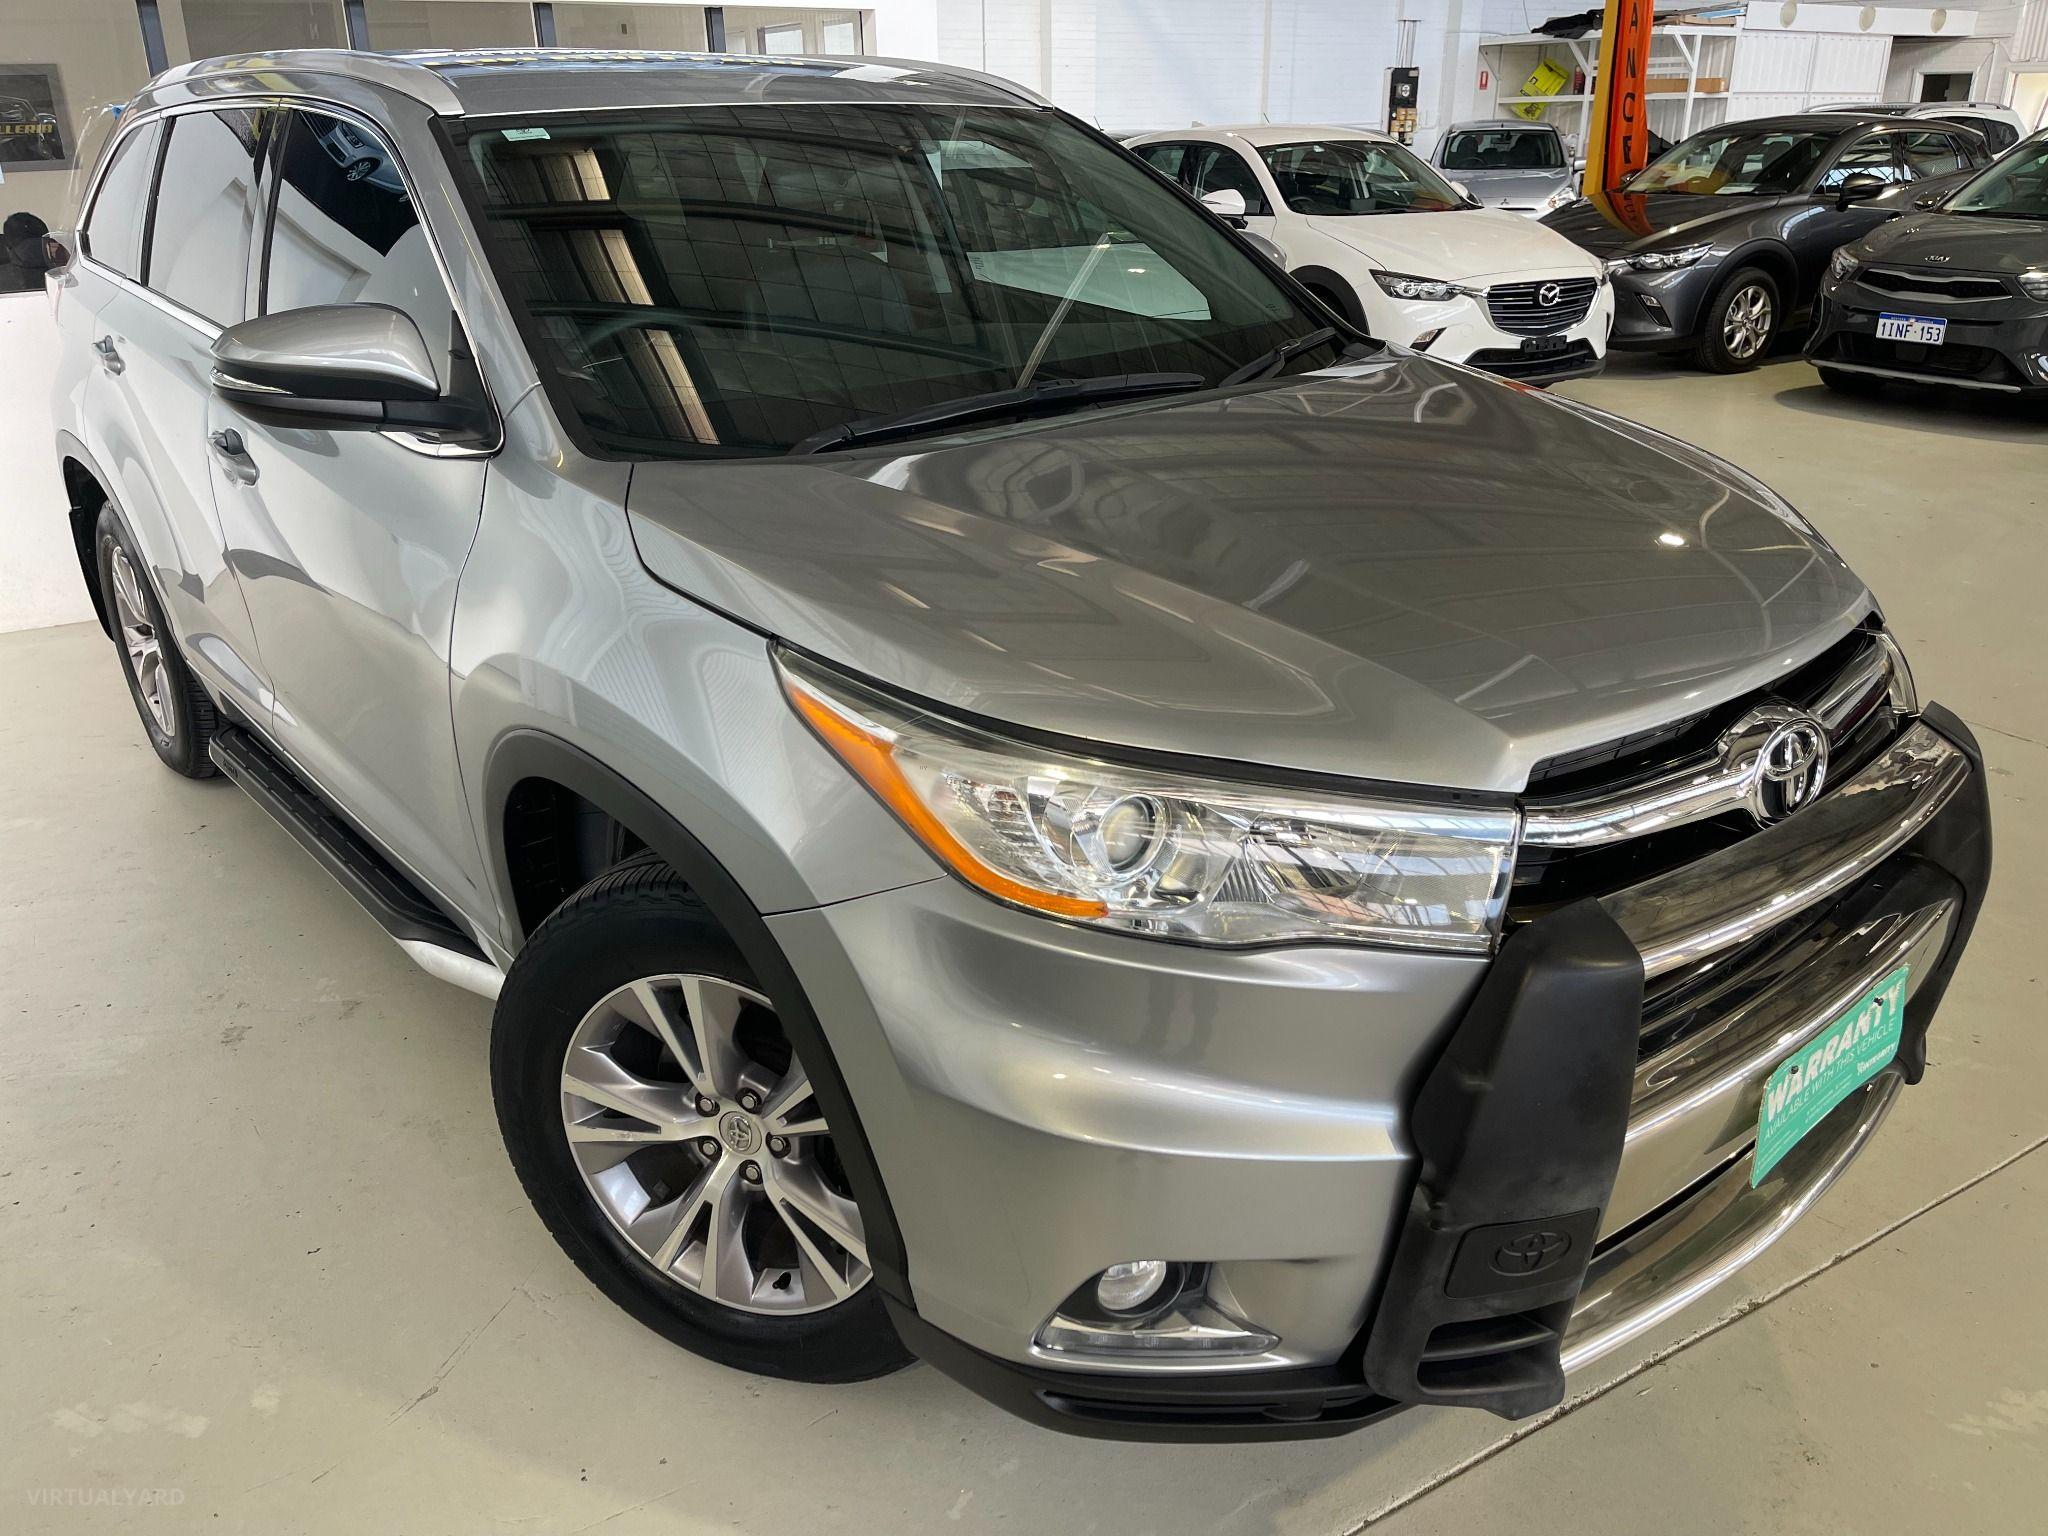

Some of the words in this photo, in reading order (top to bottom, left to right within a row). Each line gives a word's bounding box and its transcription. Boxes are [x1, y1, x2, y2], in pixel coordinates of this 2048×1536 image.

[0, 124, 53, 134] LERIA
[1765, 1086, 1811, 1140] AVAILABLE
[1812, 1065, 1834, 1095] WITH
[1856, 1017, 1897, 1056] VEHICLE
[1768, 980, 1903, 1122] WARRANTY
